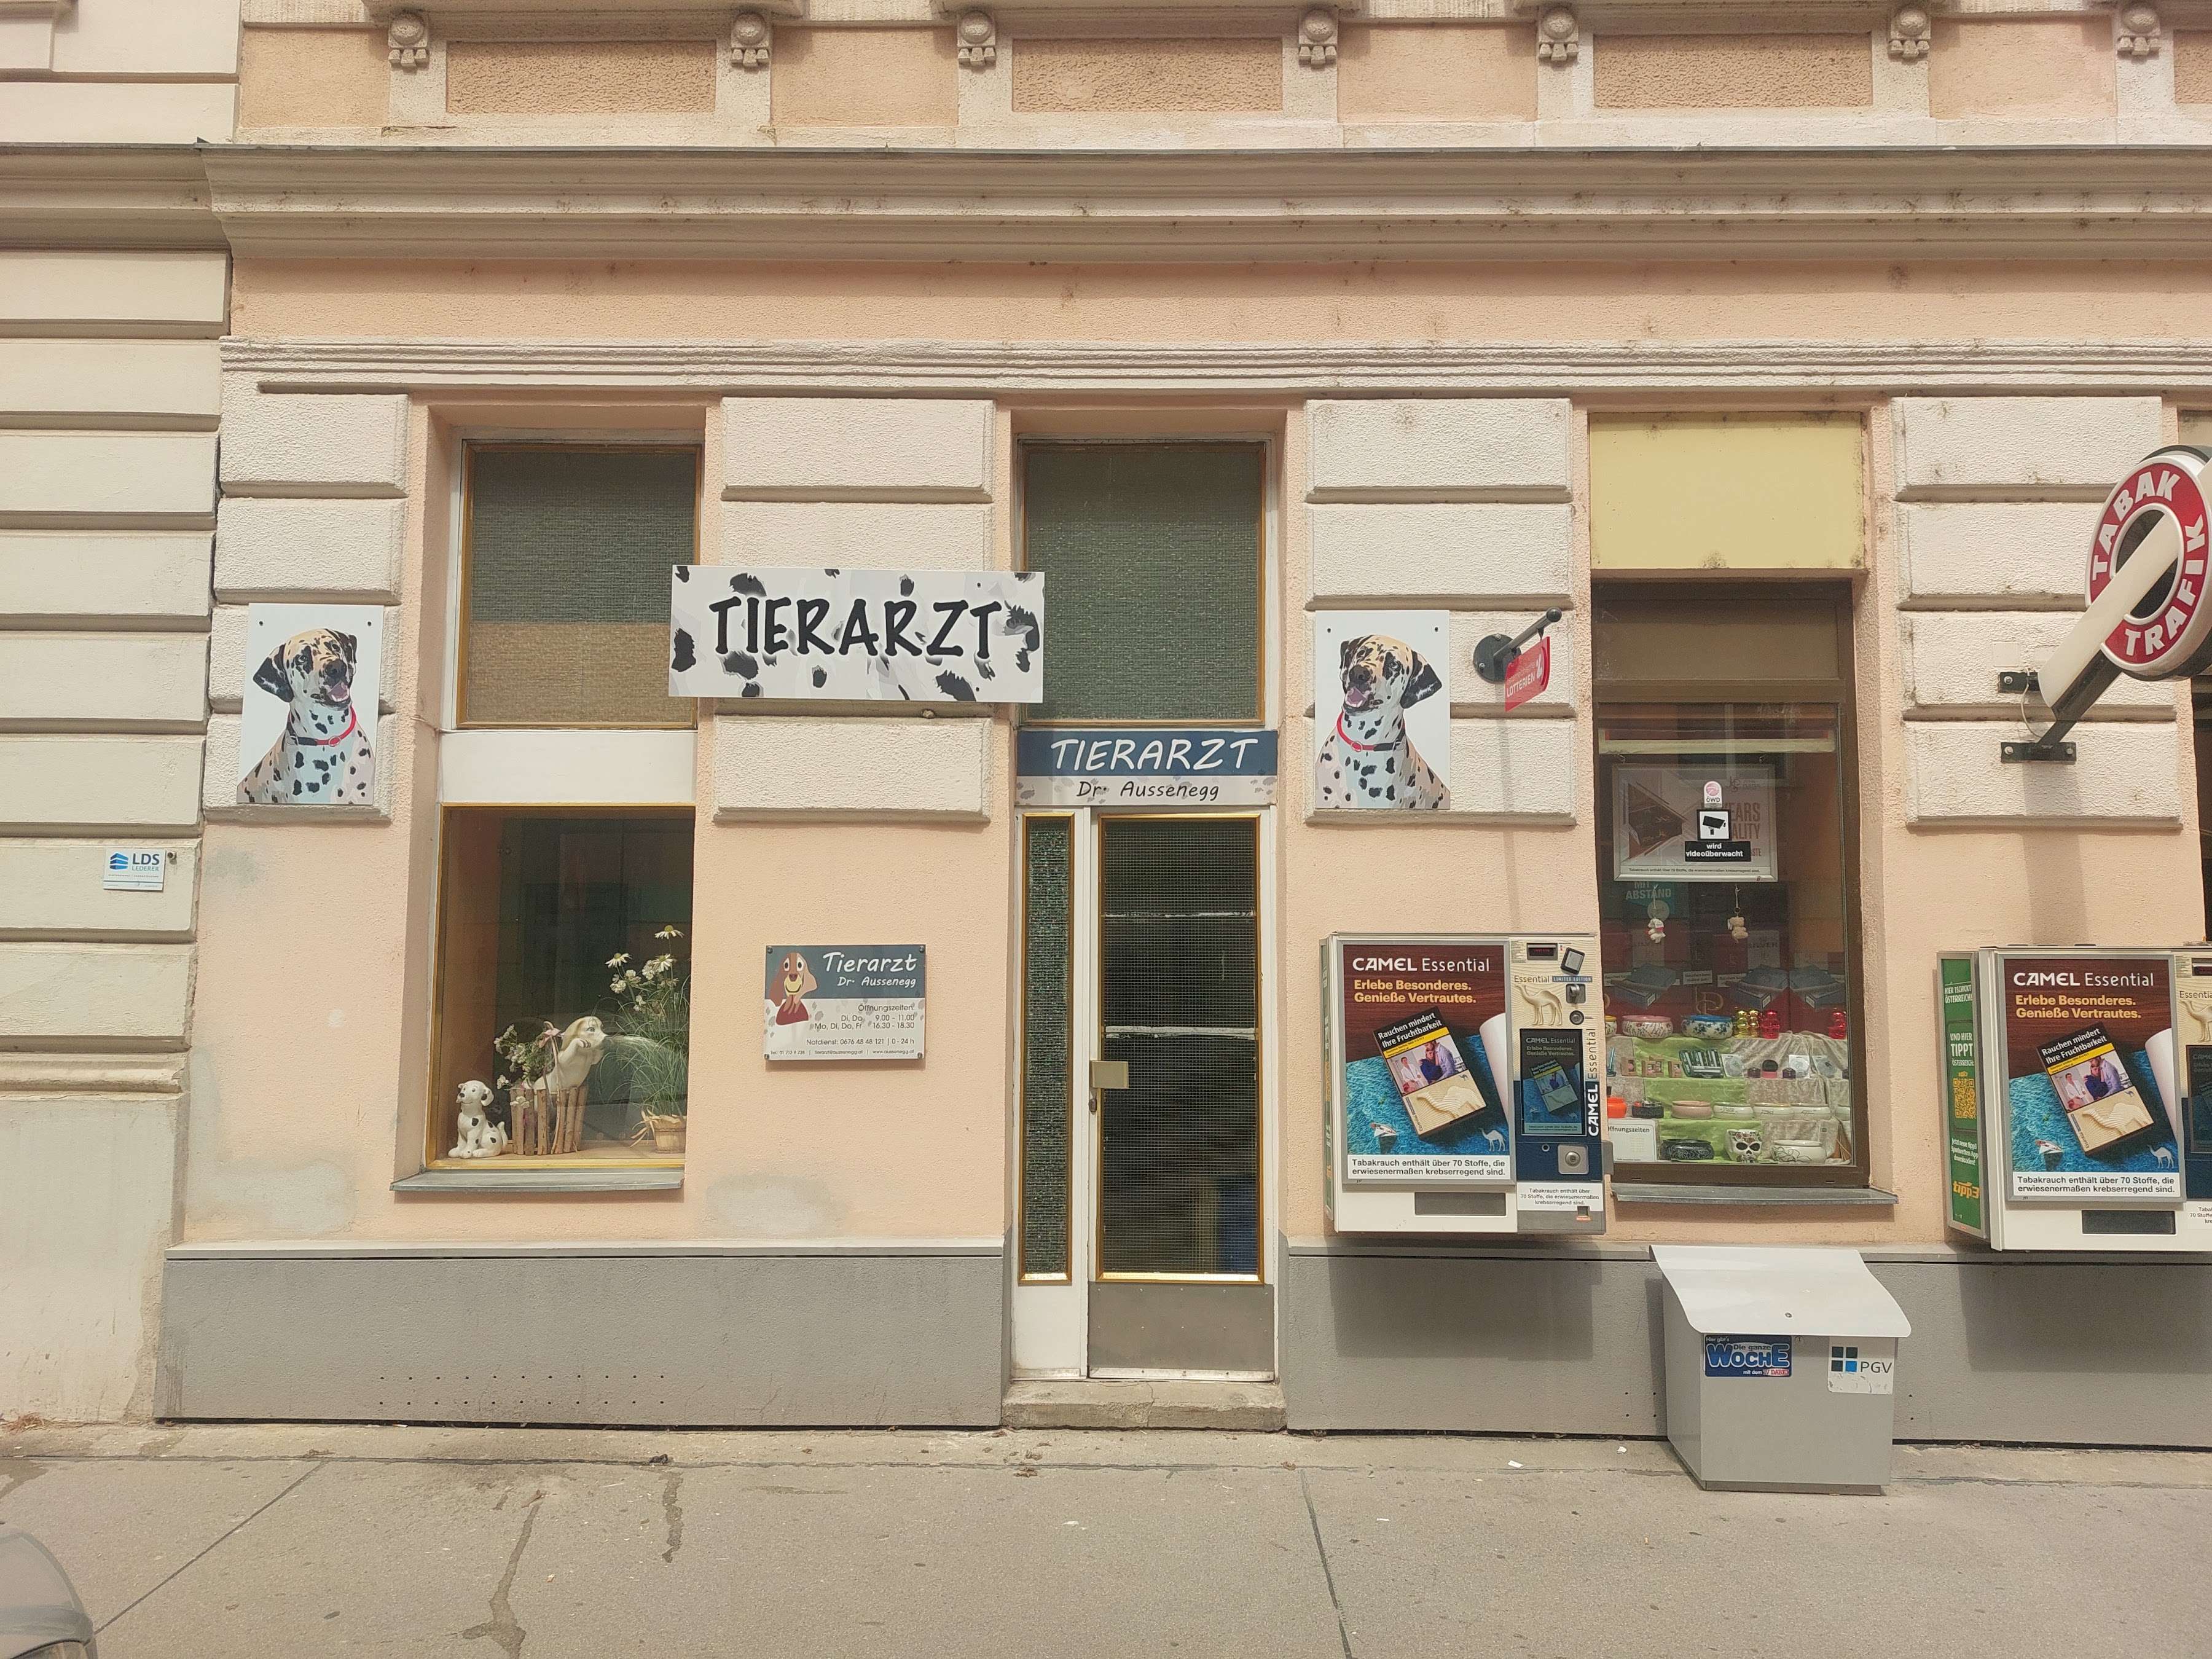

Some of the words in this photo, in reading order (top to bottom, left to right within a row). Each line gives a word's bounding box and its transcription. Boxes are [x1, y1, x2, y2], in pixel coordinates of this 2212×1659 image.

[2092, 470, 2181, 580] TABAK
[2125, 515, 2206, 656] TRAFIK
[709, 596, 1002, 659] TIERARZT
[1507, 671, 1535, 698] LOTTERIEN
[1051, 739, 1258, 771] TIERARZT
[1077, 781, 1107, 798] Dr.
[1121, 781, 1219, 801] Aussenegg
[132, 853, 160, 865] LDS
[1626, 888, 1672, 900] ABSTAND
[823, 952, 917, 973] Tierarzt
[1352, 957, 1418, 971] CAMEL
[1422, 958, 1489, 971] Essential
[837, 977, 855, 987] Dr.
[861, 976, 916, 988] Aussenegg
[1354, 979, 1393, 990] Erlebe
[1396, 979, 1472, 990] Besonderes.
[2014, 973, 2081, 986] CAMEL
[2085, 973, 2154, 986] Essential
[1354, 992, 1406, 1003] Genieße
[1408, 993, 1477, 1003] Vertrautes.
[2015, 995, 2056, 1005] Erlebe
[2058, 995, 2136, 1006] Besonderes.
[858, 1003, 915, 1012] Öffnungszeiten:
[2016, 1008, 2069, 1018] Genieße
[2071, 1008, 2141, 1018] Vertrautes.
[1378, 1024, 1408, 1040] Rauchen
[1408, 1013, 1436, 1028] mindert
[1382, 1039, 1397, 1048] Ihre
[1397, 1020, 1442, 1041] Fruchtbarkeit
[1961, 1032, 1972, 1041] HIER
[2041, 1040, 2072, 1057] Rauchen
[2073, 1028, 2101, 1045] mindert
[1586, 1029, 1597, 1079] Essential
[1951, 1043, 1973, 1057] TIPPT
[2045, 1055, 2061, 1064] Ihre
[2061, 1035, 2108, 1058] Fruchtbarkeit
[1587, 1084, 1599, 1136] CAMEL
[1426, 1168, 1484, 1177] krebserregend
[1953, 1180, 1980, 1199] tipp3
[2093, 1185, 2152, 1194] krebserregend
[1706, 1343, 1790, 1368] WOCHE
[1860, 1362, 1892, 1373] PGV
